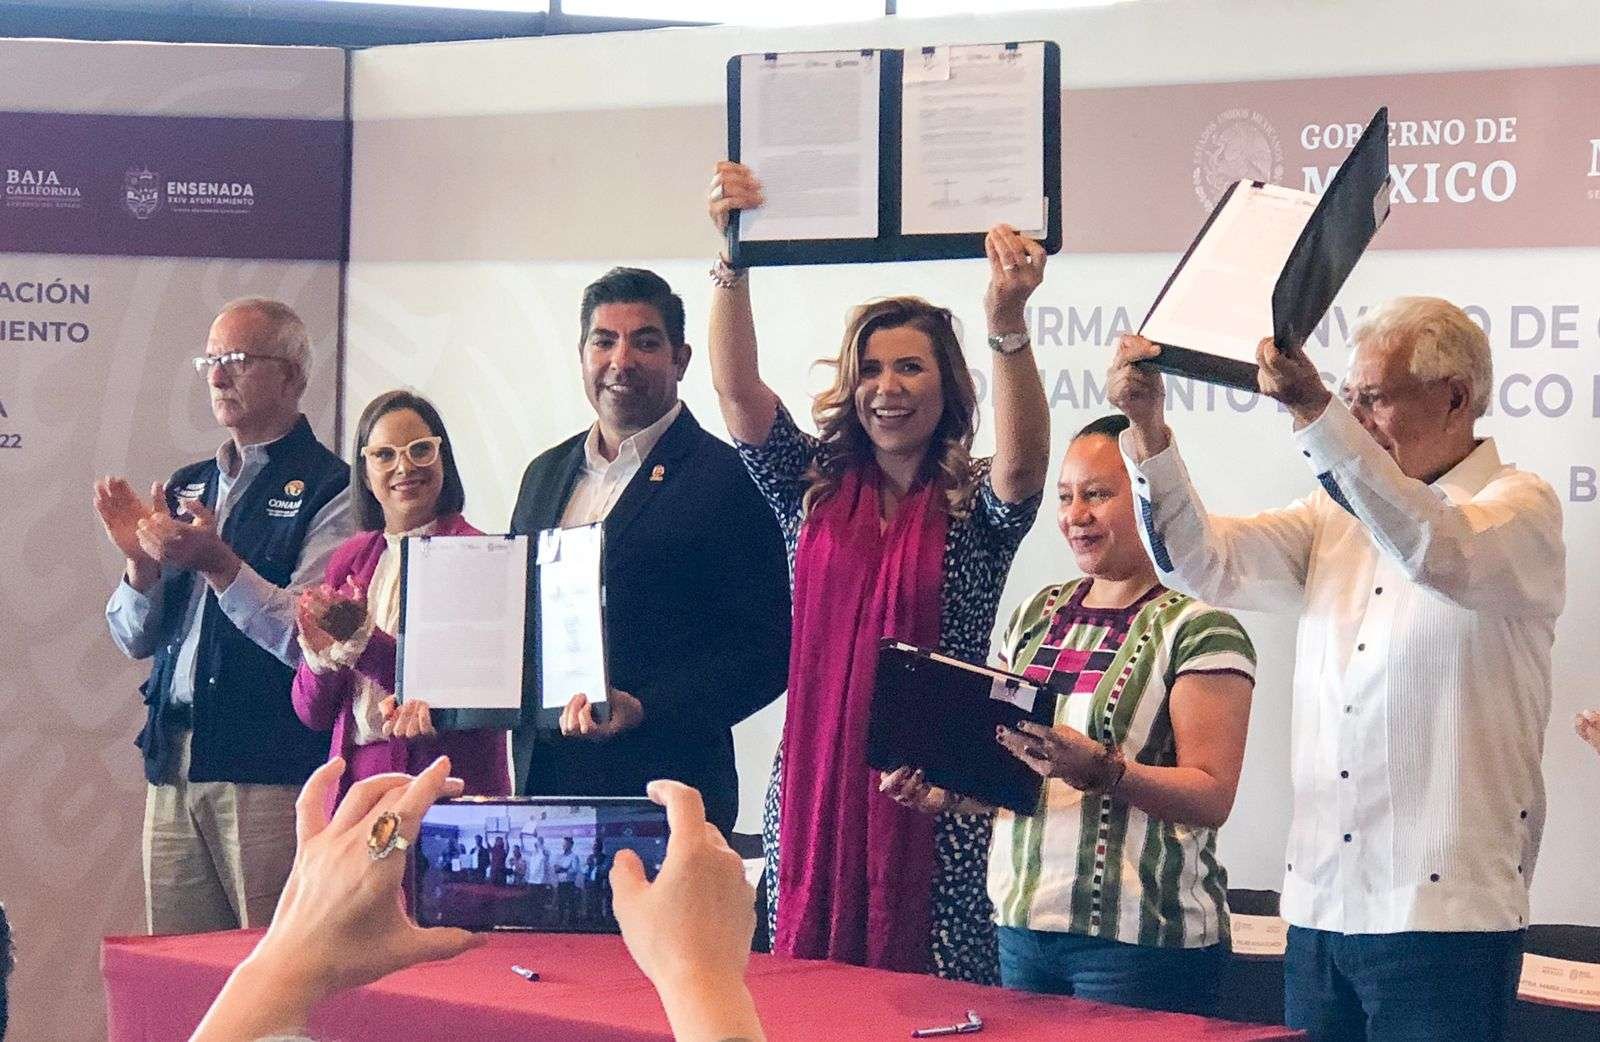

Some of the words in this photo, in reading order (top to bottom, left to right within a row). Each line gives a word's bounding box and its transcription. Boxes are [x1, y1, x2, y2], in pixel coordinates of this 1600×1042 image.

[1475, 117, 1518, 144] DE
[7, 169, 60, 185] BAJA
[1302, 160, 1517, 204] MXICO
[6, 185, 81, 197] CALIFORNIA
[167, 181, 254, 197] ENSENADA
[189, 197, 255, 206] AYUNTAMIENTO
[1510, 305, 1580, 349] DE
